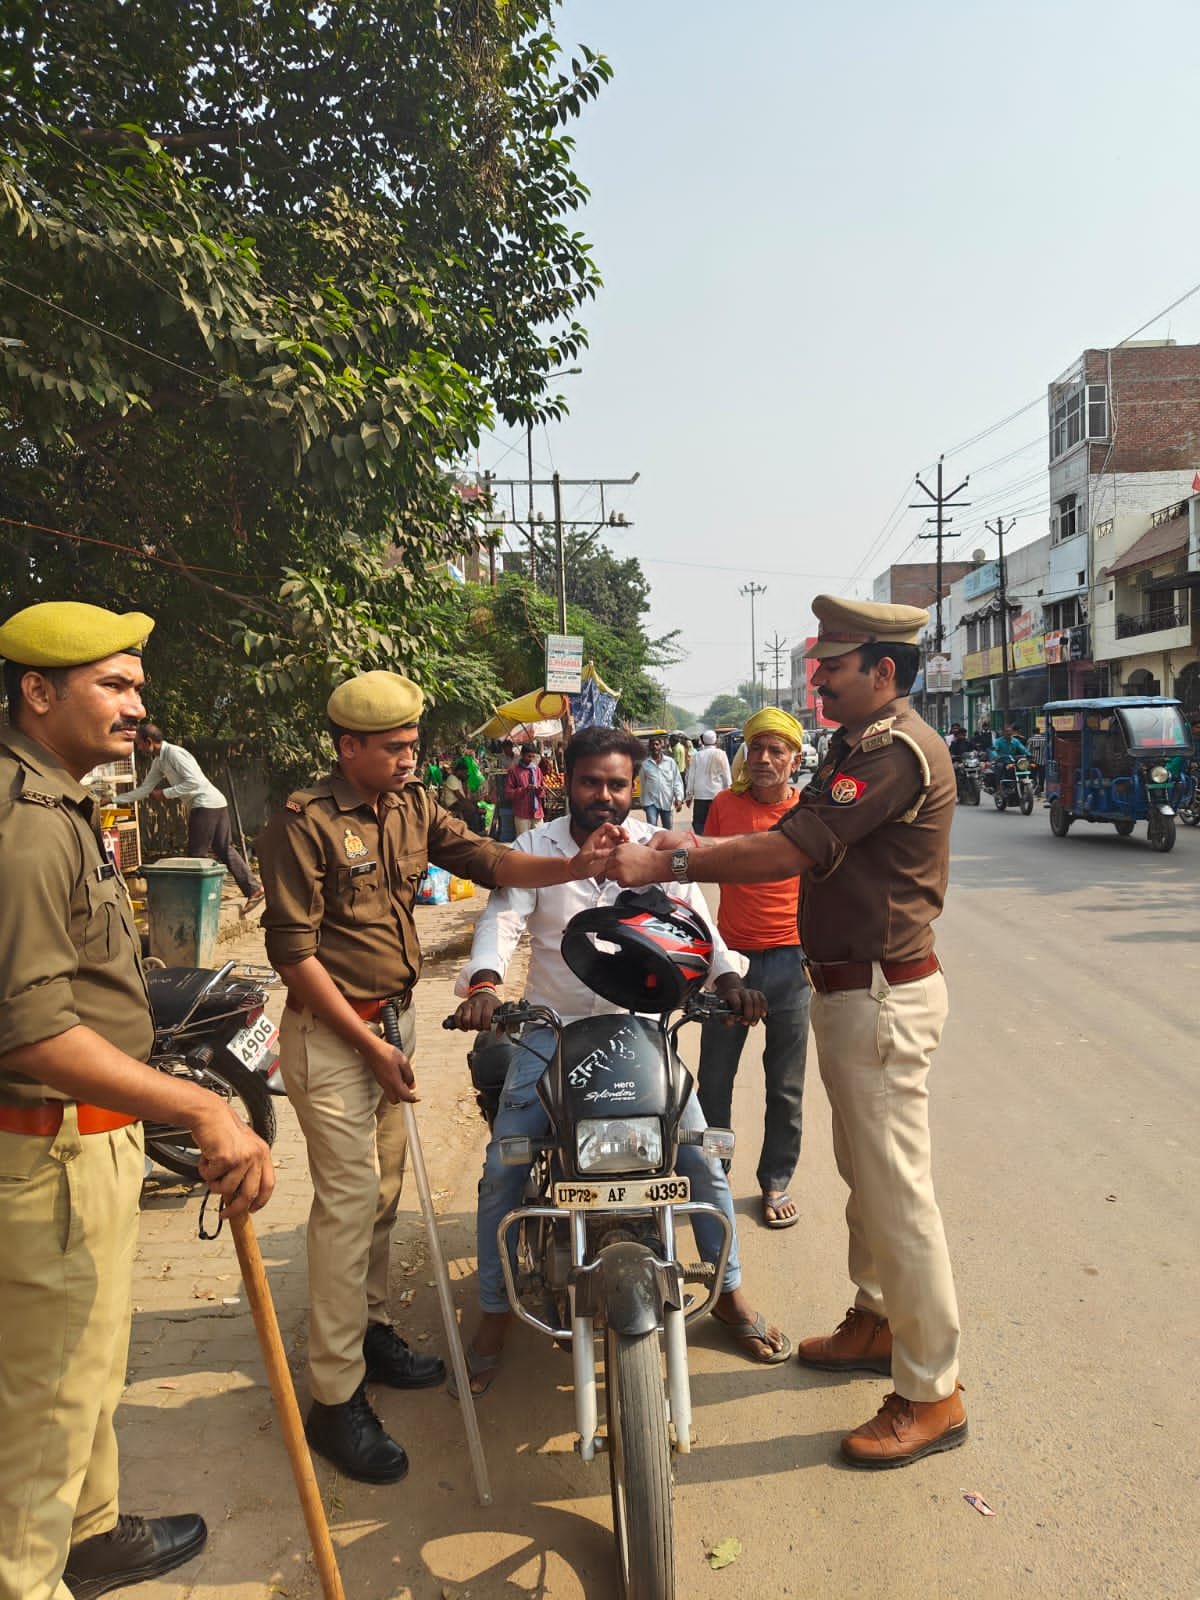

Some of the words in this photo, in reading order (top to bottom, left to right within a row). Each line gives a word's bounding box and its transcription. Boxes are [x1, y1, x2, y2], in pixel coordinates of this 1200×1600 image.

[241, 1020, 272, 1062] 4906
[558, 1189, 592, 1203] UP72
[607, 1187, 627, 1202] AF
[649, 1181, 689, 1201] 0393
